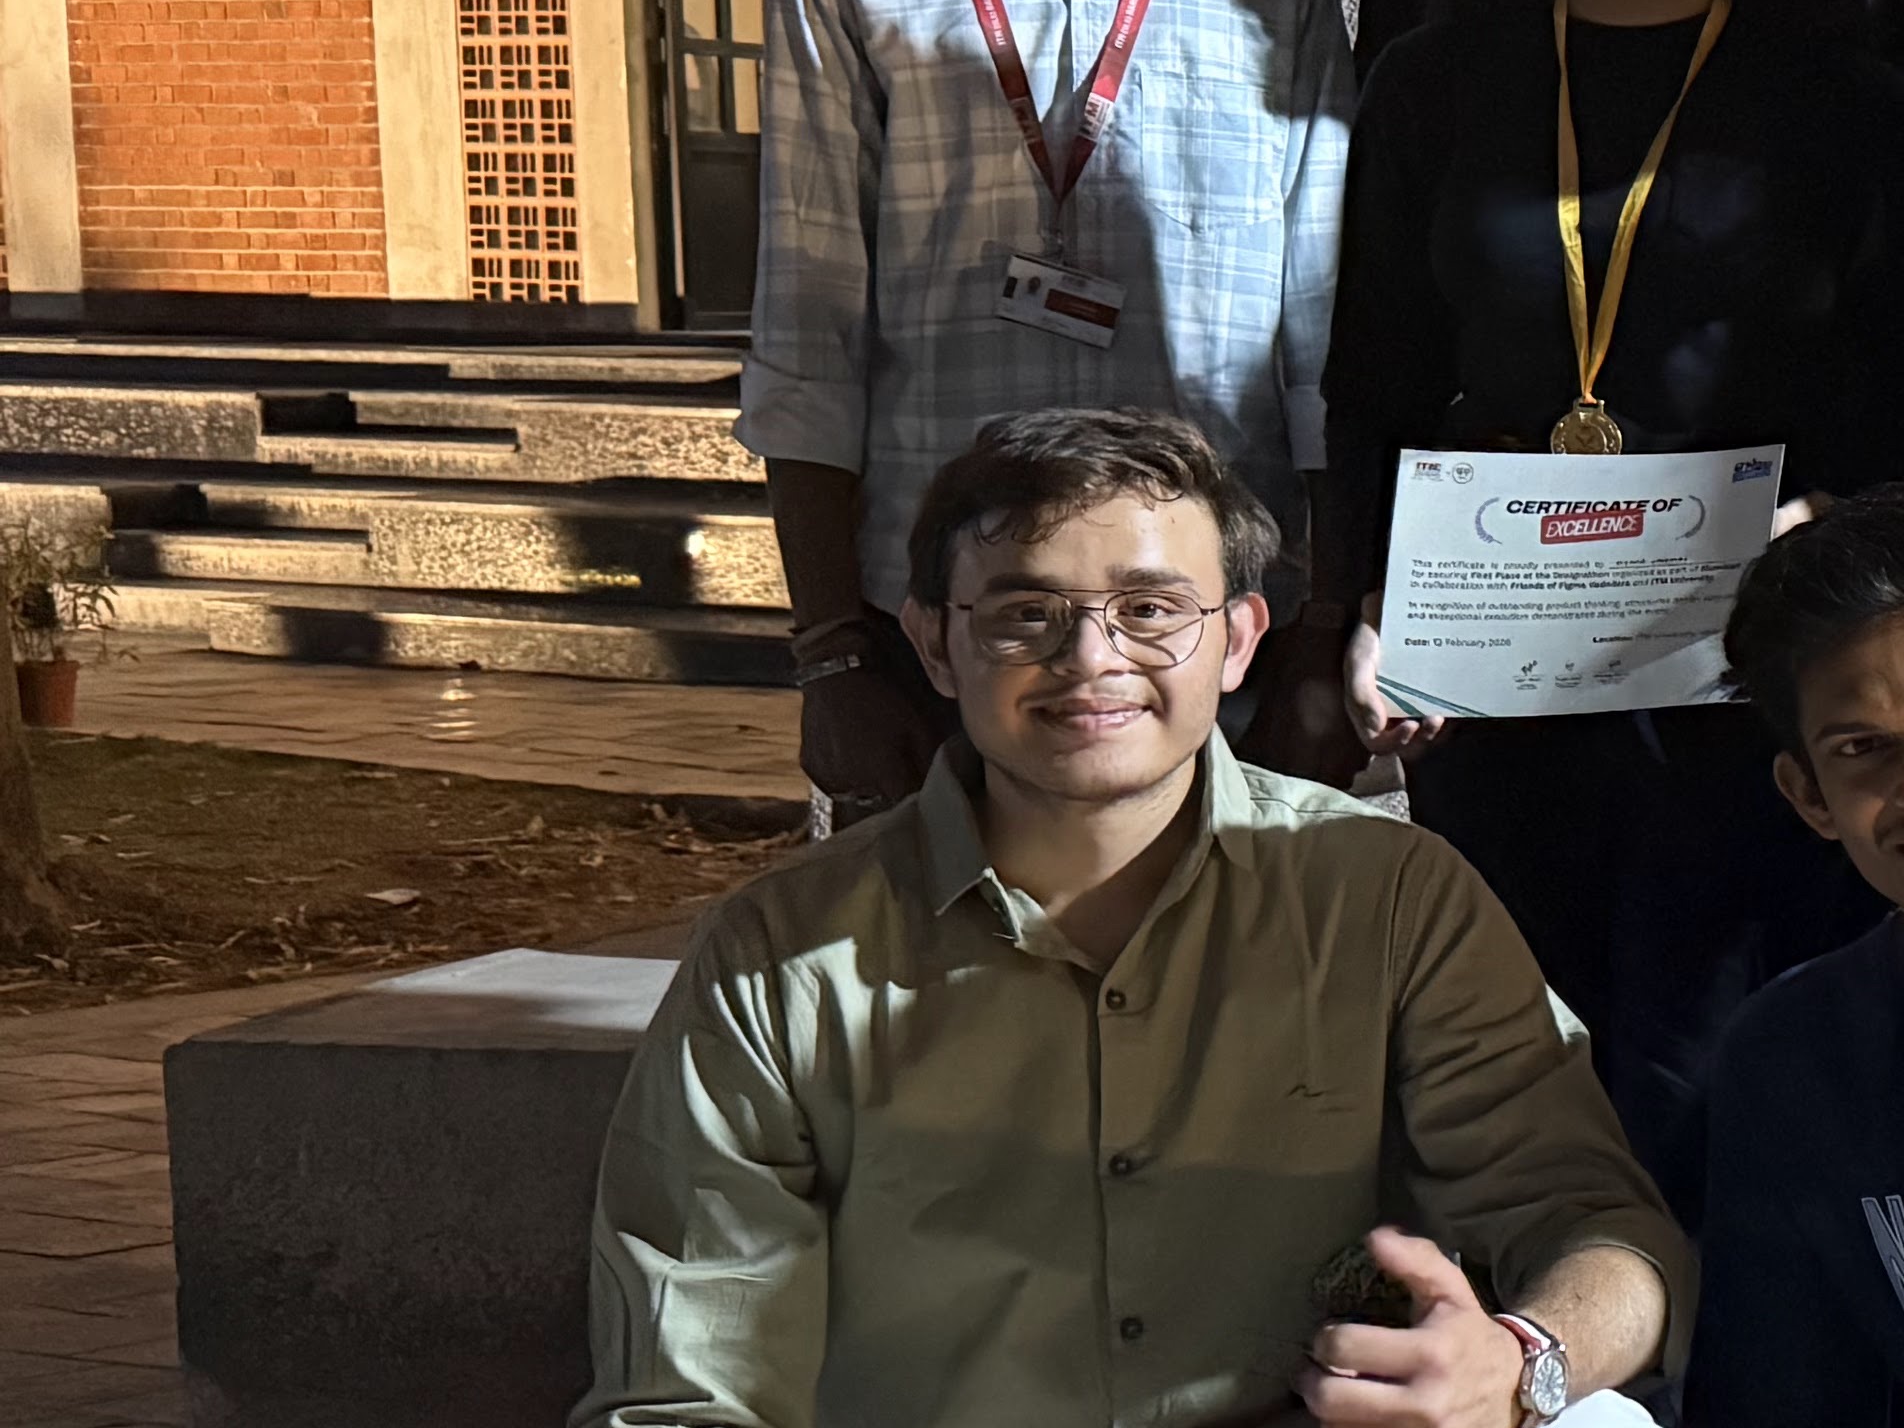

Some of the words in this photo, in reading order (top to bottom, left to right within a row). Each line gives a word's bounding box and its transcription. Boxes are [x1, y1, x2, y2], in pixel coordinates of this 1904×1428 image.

[1506, 499, 1650, 515] CERTIFICATE
[1652, 498, 1683, 513] OF
[1545, 515, 1641, 538] EXCELLENCE
